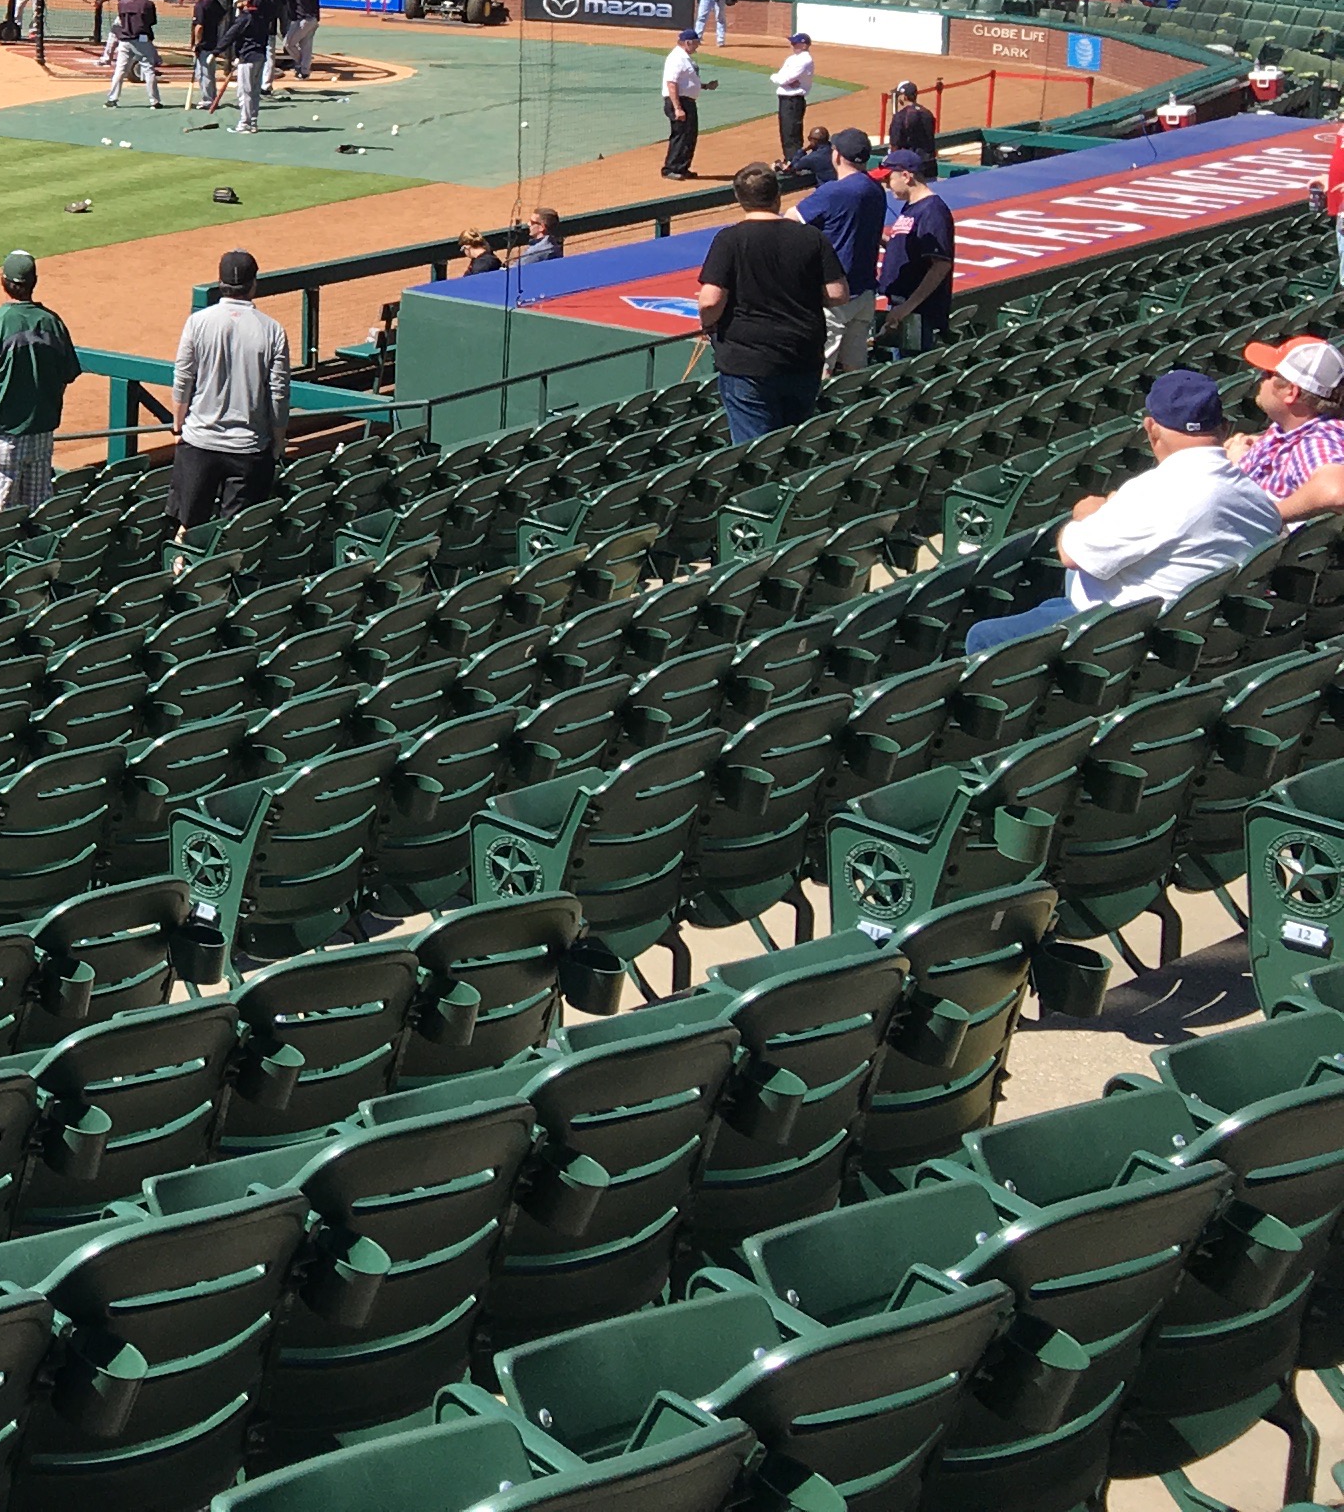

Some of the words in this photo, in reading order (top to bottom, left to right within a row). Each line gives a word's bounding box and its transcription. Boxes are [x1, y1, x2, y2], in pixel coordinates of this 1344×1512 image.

[972, 24, 1018, 40] GLOBE
[1020, 28, 1045, 44] LIFE
[992, 43, 1029, 59] PARK
[1297, 928, 1312, 941] 12
